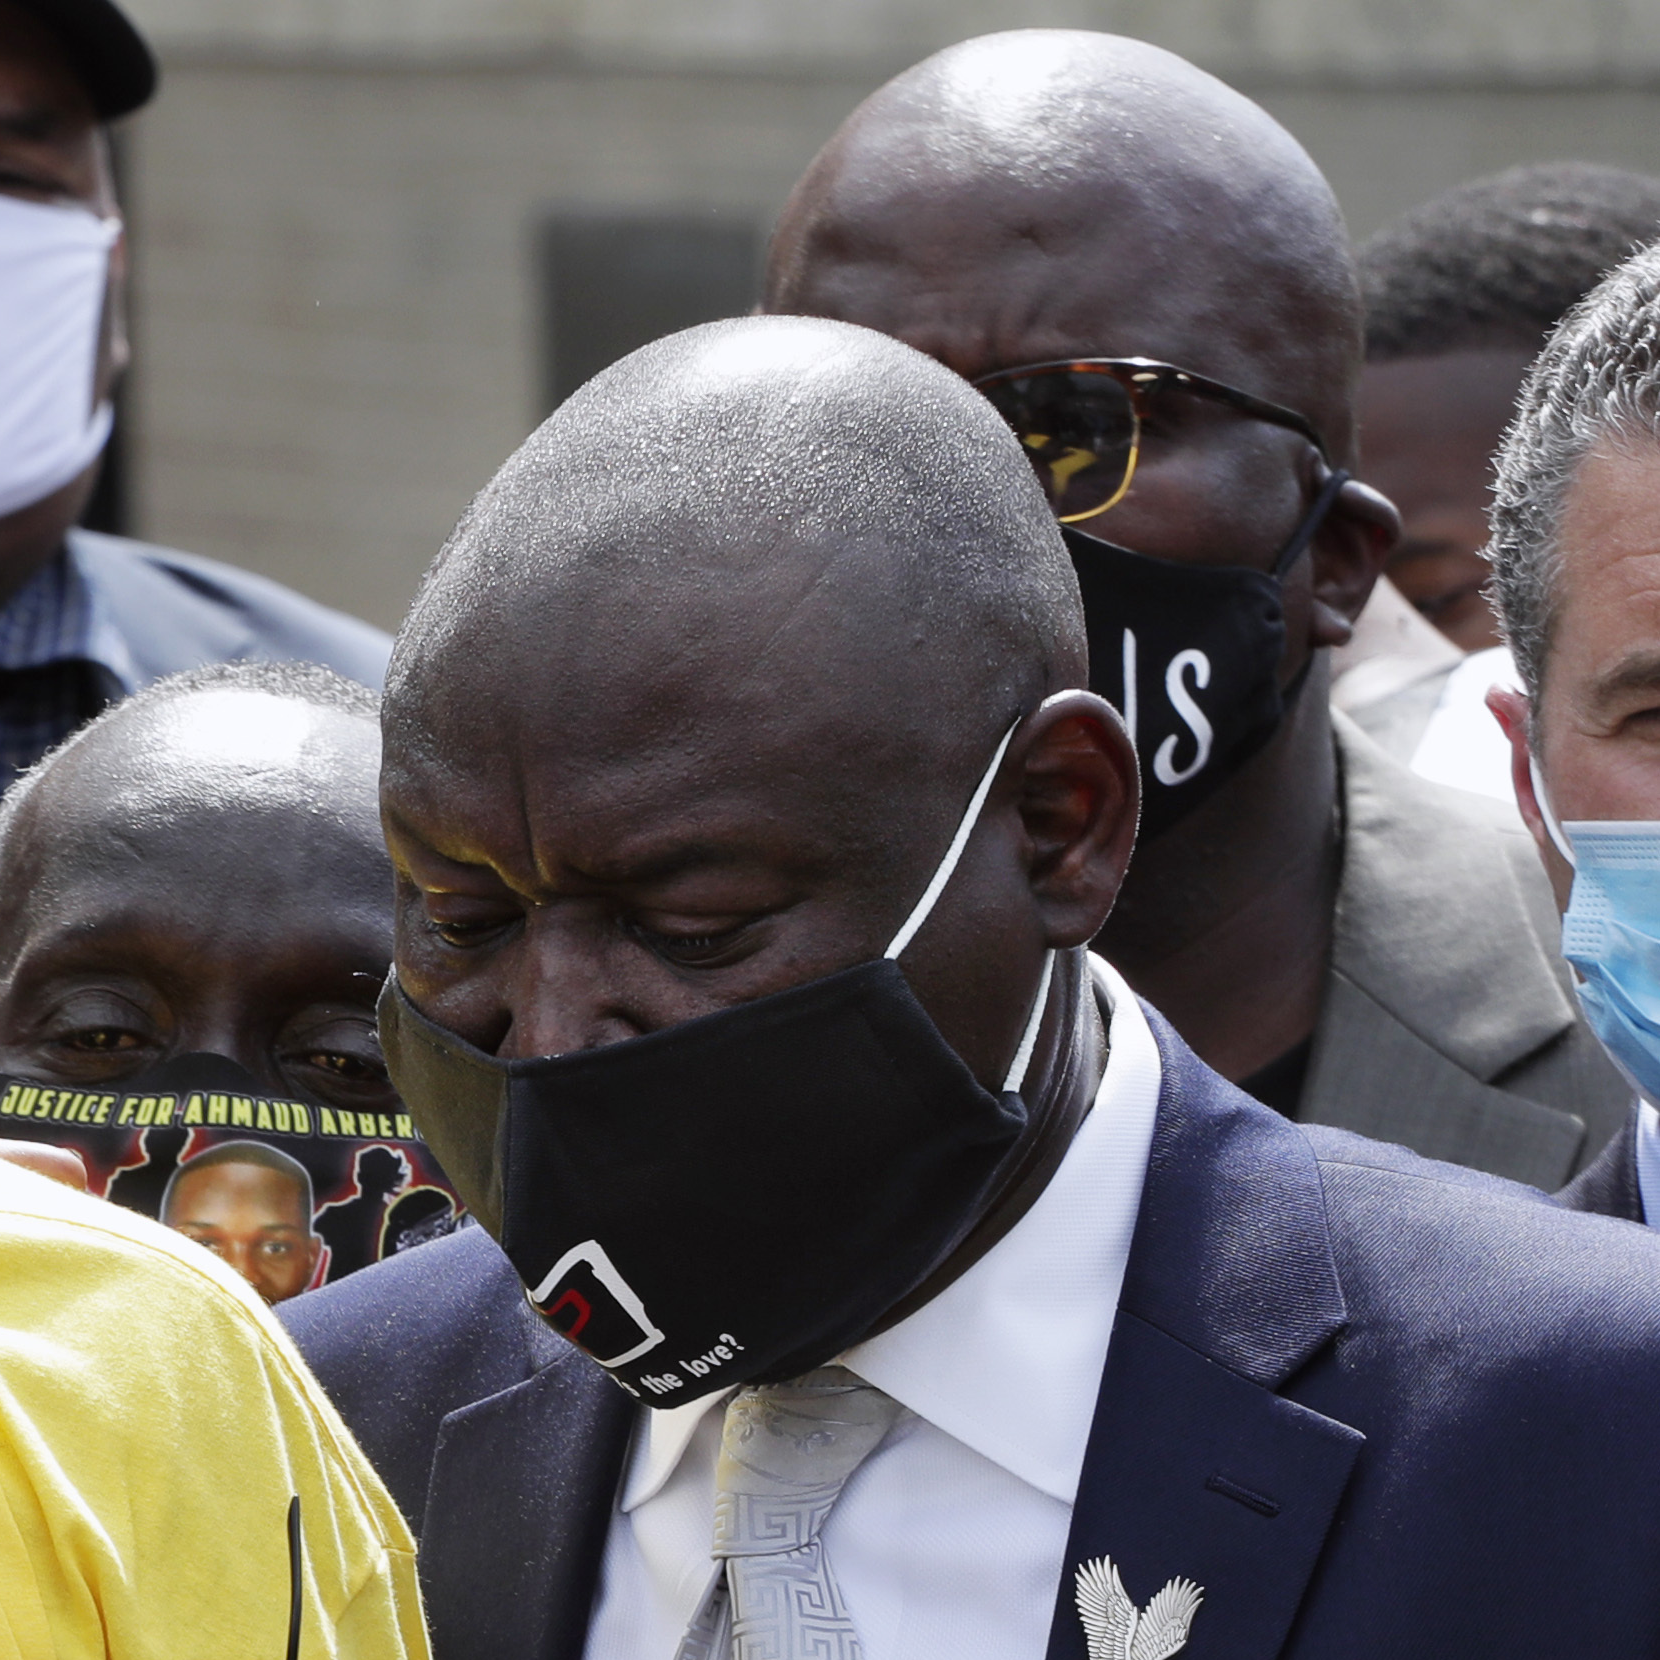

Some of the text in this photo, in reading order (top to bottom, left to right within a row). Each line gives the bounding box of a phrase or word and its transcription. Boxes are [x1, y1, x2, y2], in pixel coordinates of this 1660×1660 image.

[0, 1085, 424, 1140] JUSTICE FOR AHMAUD ARBER
[640, 1372, 684, 1396] the
[679, 1333, 745, 1378] love?
